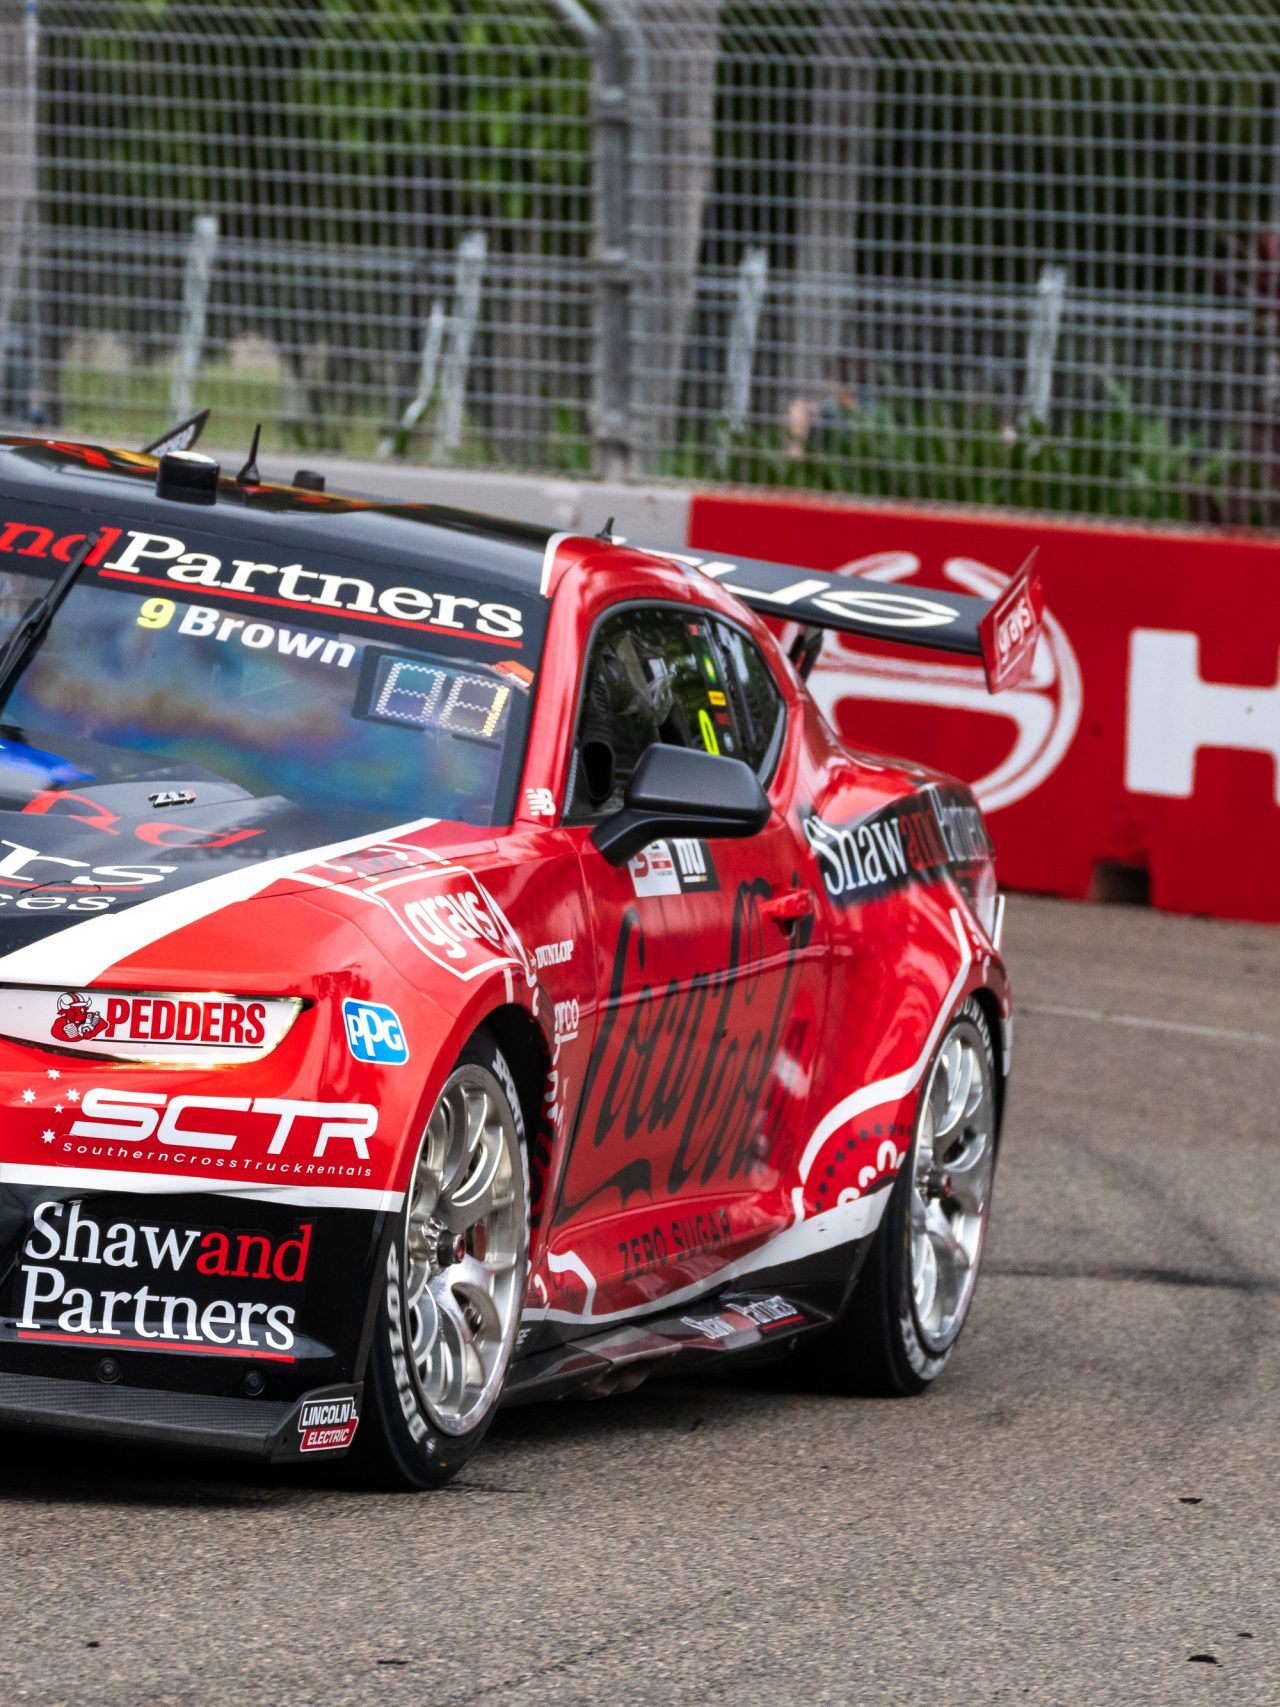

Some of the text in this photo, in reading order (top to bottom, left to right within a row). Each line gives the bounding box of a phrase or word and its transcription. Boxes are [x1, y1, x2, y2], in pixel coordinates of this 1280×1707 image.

[136, 597, 357, 669] 9 Brown
[404, 890, 503, 959] grays
[535, 939, 575, 970] DUNLOP
[105, 998, 266, 1045] PEDDERS
[348, 1006, 405, 1057] PPG
[70, 1087, 379, 1160] SCTR
[15, 1264, 296, 1351] Partners
[301, 1403, 351, 1427] LINCOLN
[306, 1428, 350, 1446] ELECTRIC
